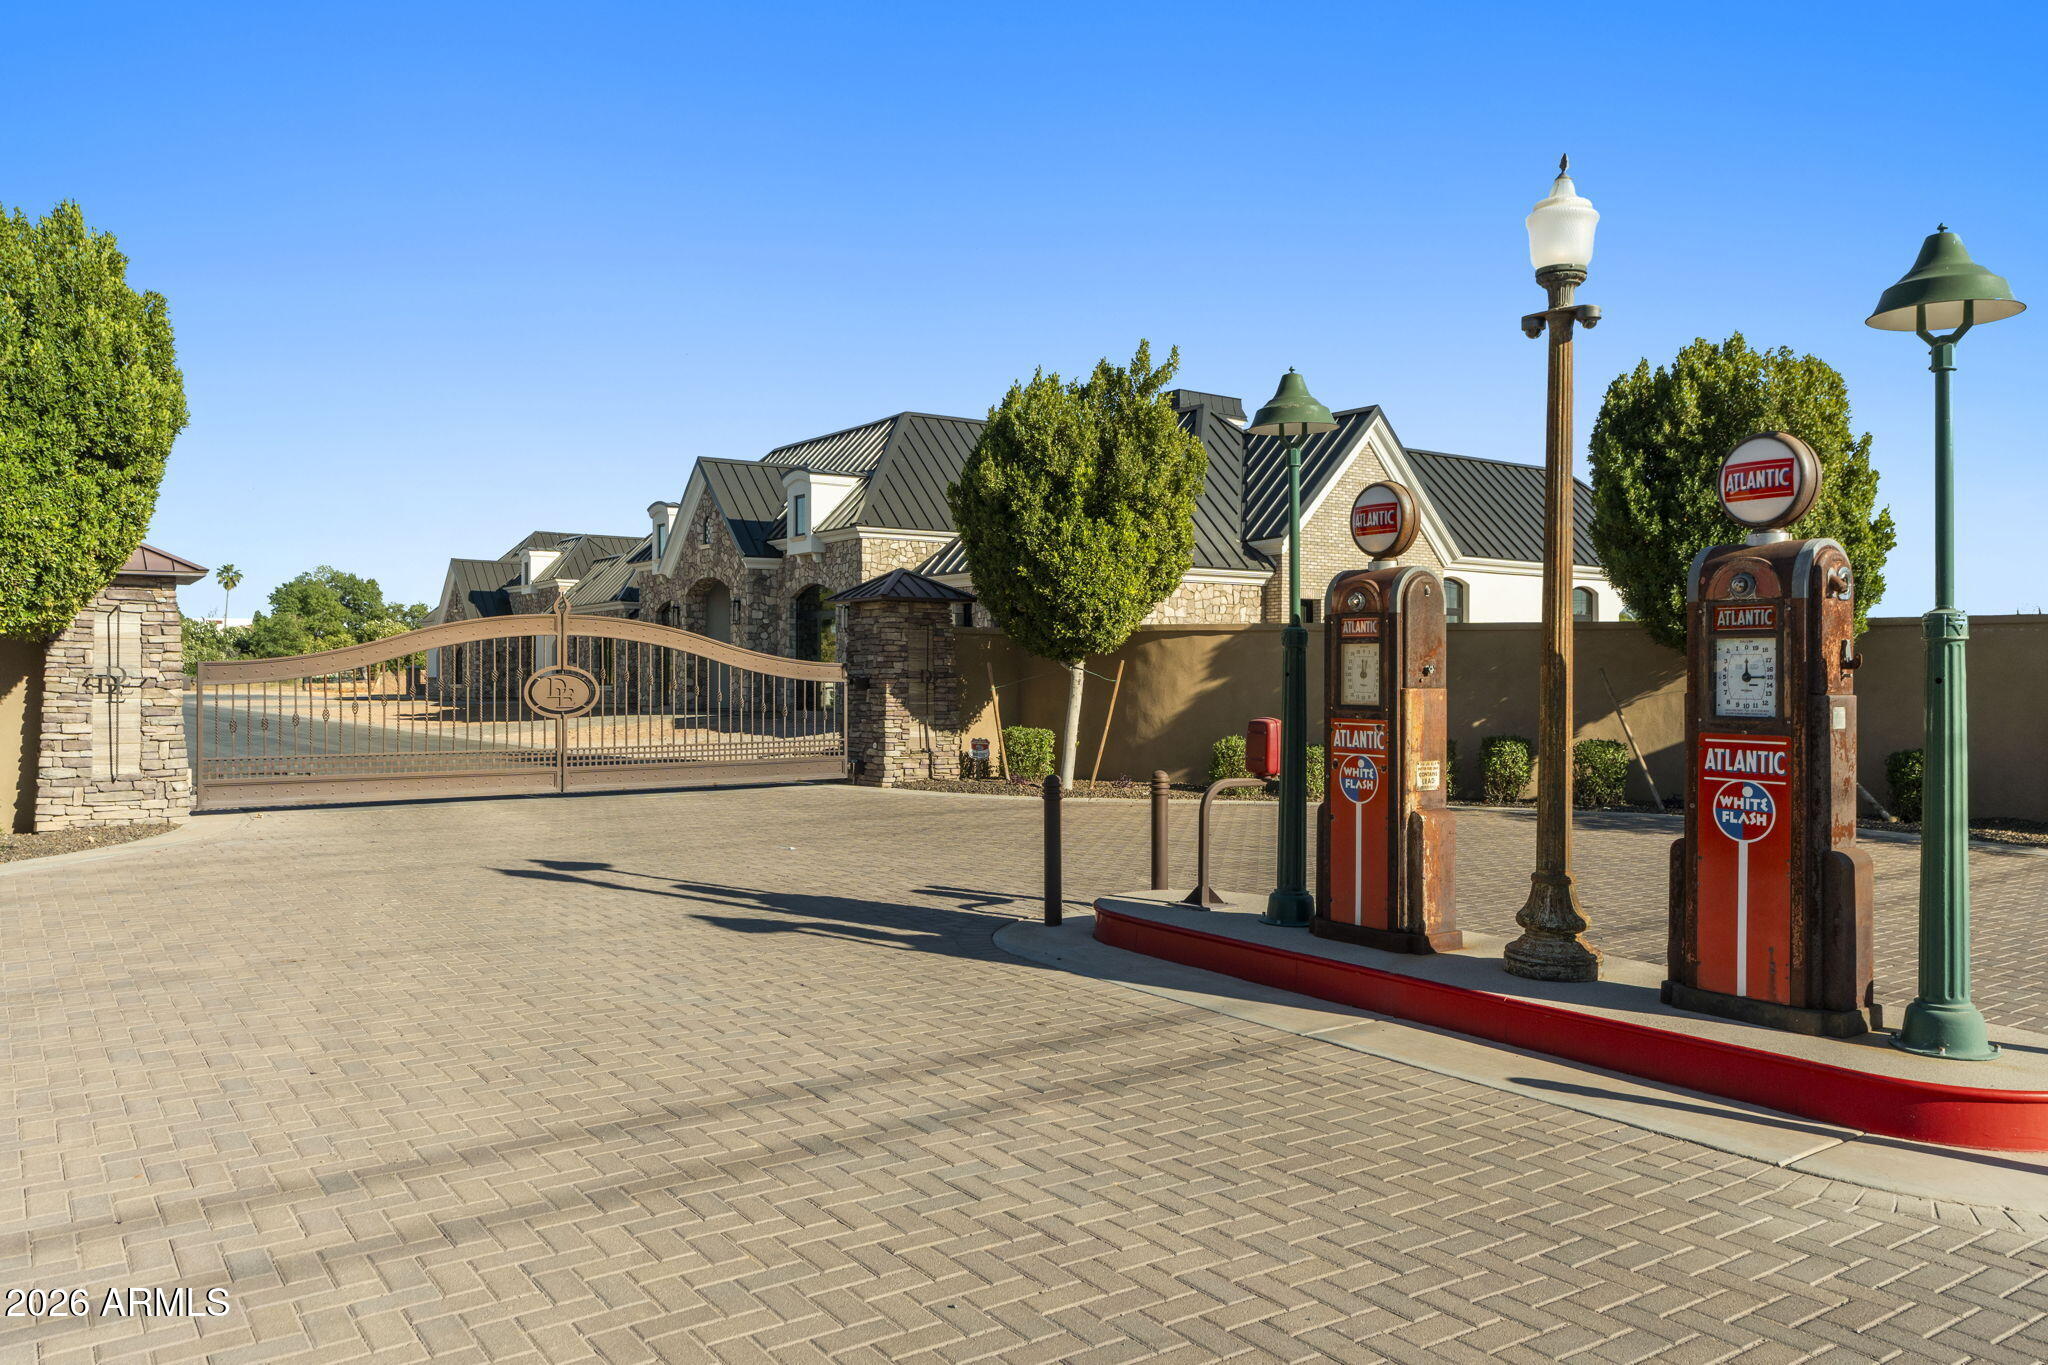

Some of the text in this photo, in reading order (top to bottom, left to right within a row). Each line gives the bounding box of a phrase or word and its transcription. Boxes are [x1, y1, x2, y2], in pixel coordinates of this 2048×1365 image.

[1726, 468, 1790, 492] ATLANTIC
[1355, 509, 1395, 528] ATLANTIC
[1342, 620, 1378, 633] ATLANTIC
[1717, 609, 1773, 626] ATLANTIC
[1333, 729, 1385, 749] ATLANTIC
[1705, 747, 1786, 775] ATLANTIC
[1343, 763, 1374, 779] WHITE
[1345, 779, 1373, 790] FLASH
[1719, 791, 1768, 811] WHITE
[1722, 811, 1767, 826] FLASH
